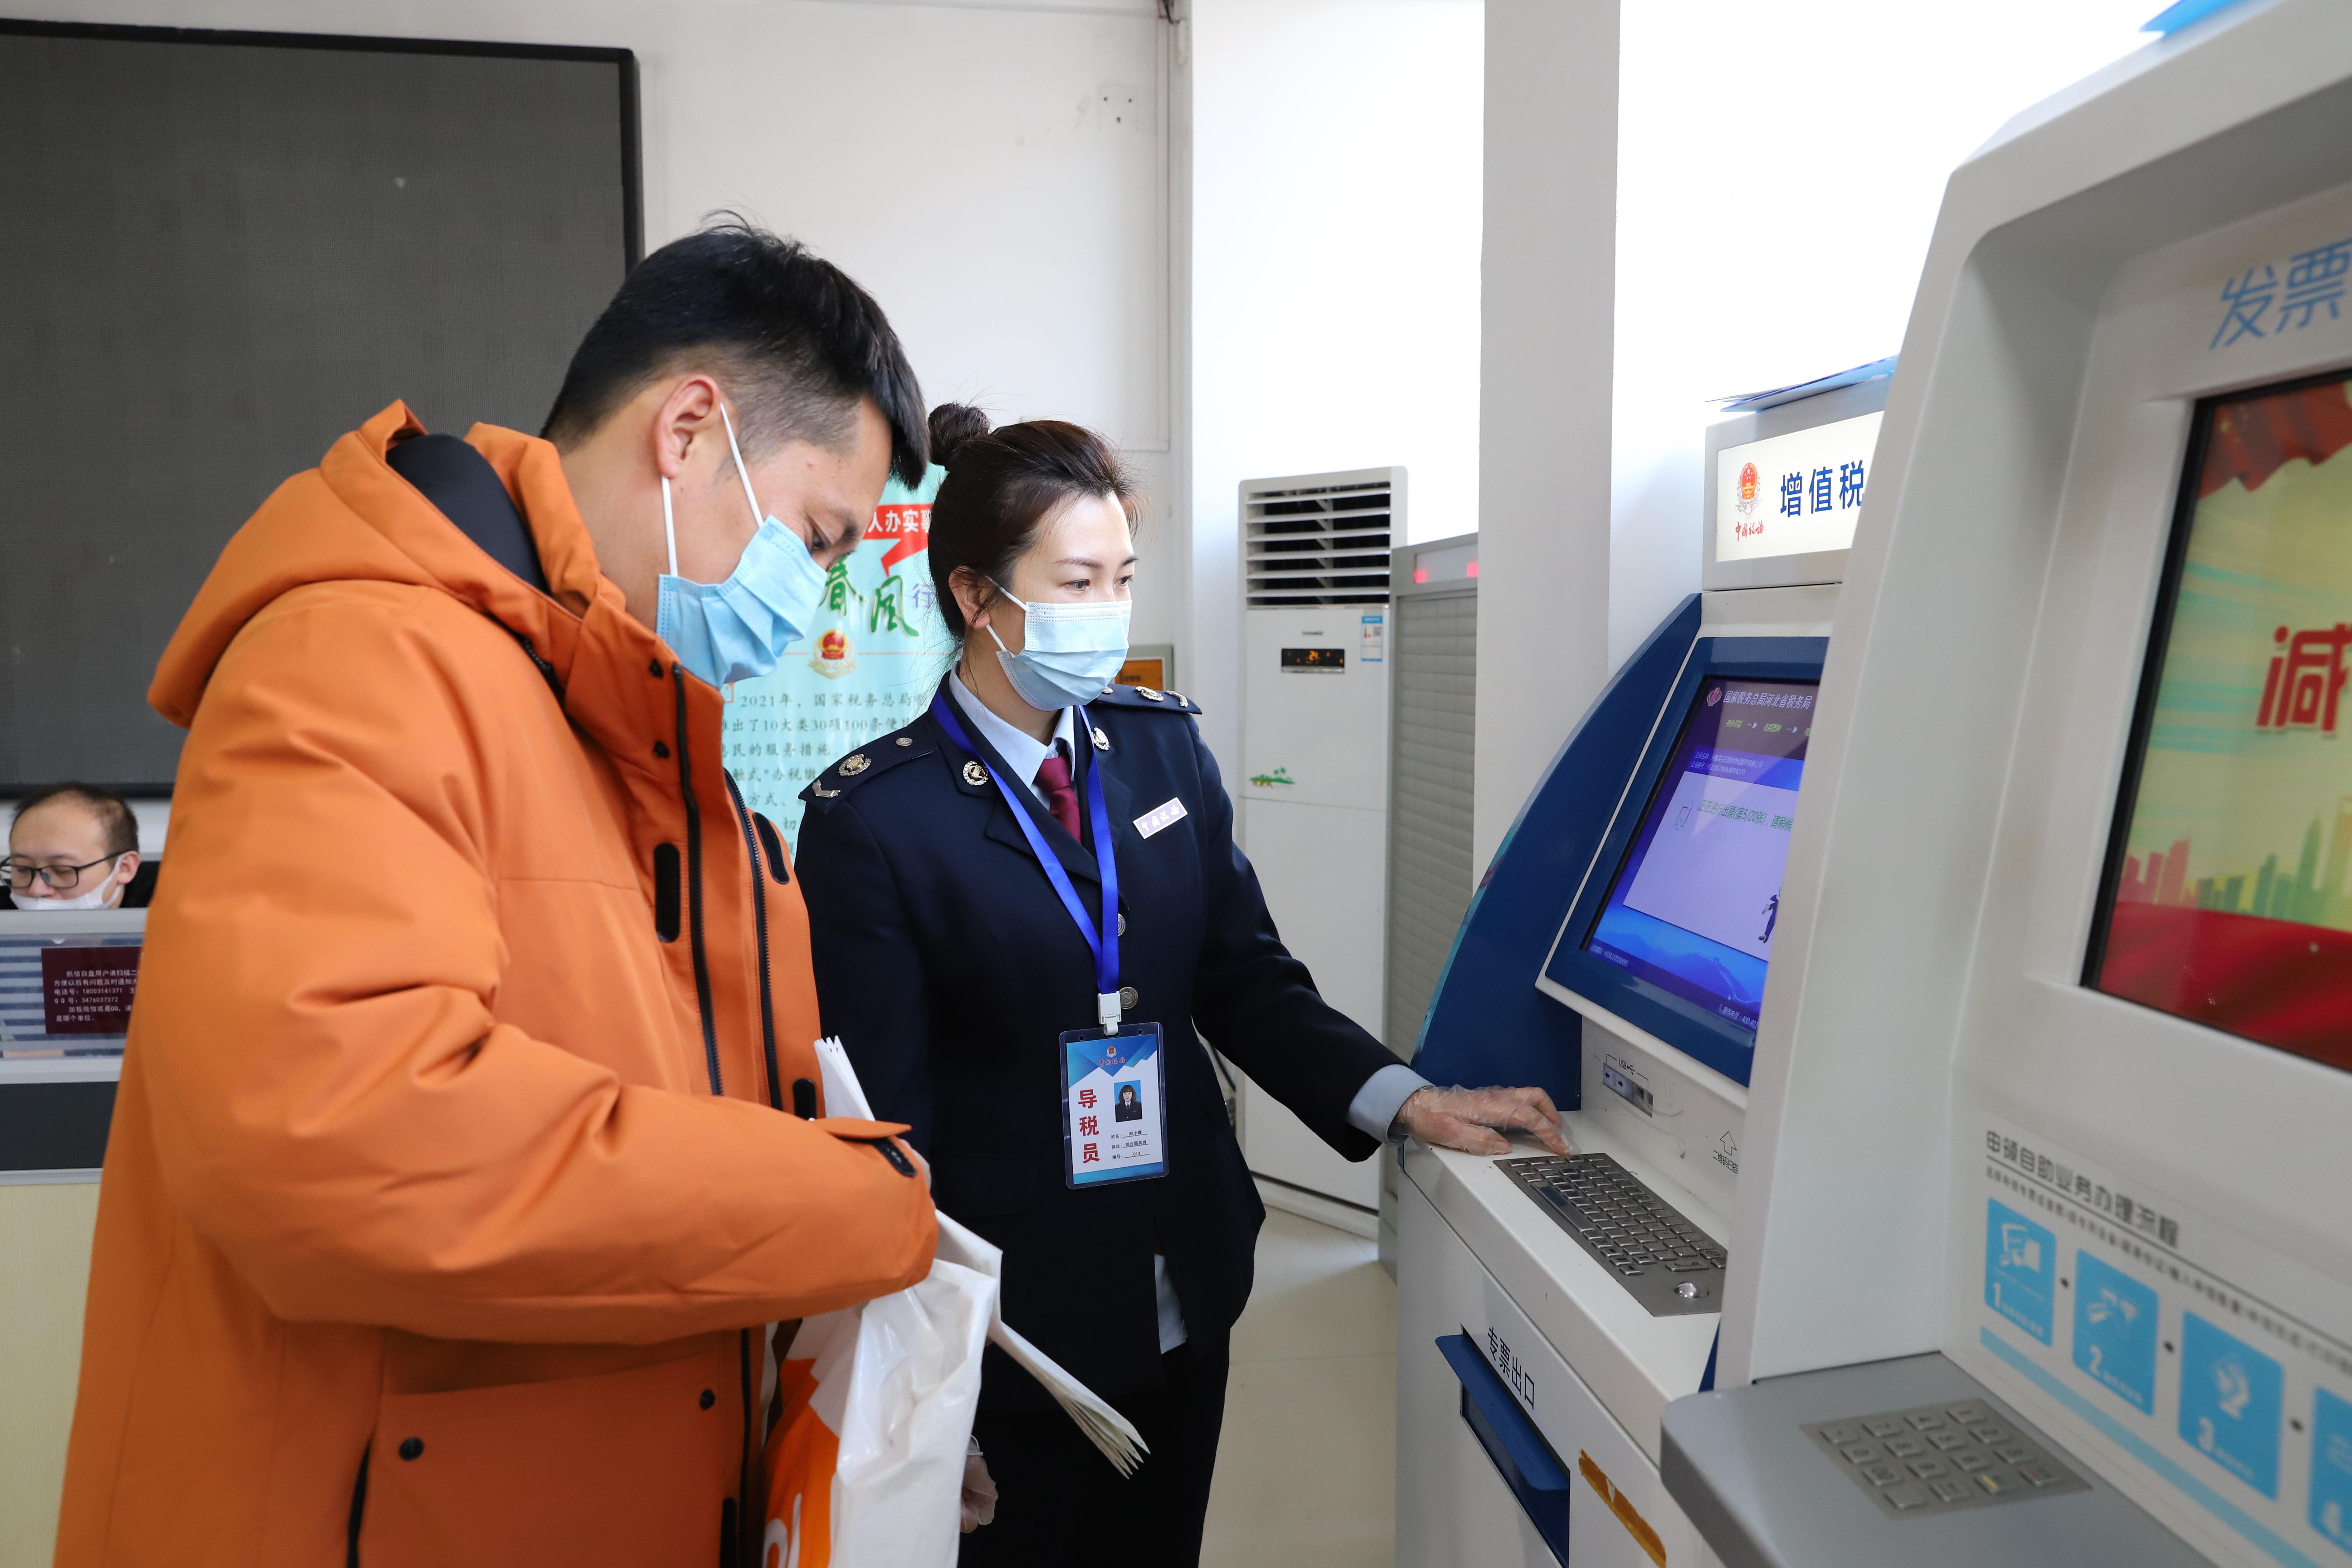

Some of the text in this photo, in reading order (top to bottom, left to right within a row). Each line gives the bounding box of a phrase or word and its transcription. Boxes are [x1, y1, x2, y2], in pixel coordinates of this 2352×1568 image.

[2210, 238, 2352, 351] 发票
[1780, 459, 1864, 518] 增值税
[1735, 521, 1764, 542] 中国税务
[1723, 691, 1813, 709] 国家税务总局河北省税务局
[1078, 1089, 1100, 1164] 导税员
[1488, 1326, 1534, 1410] 专票出口
